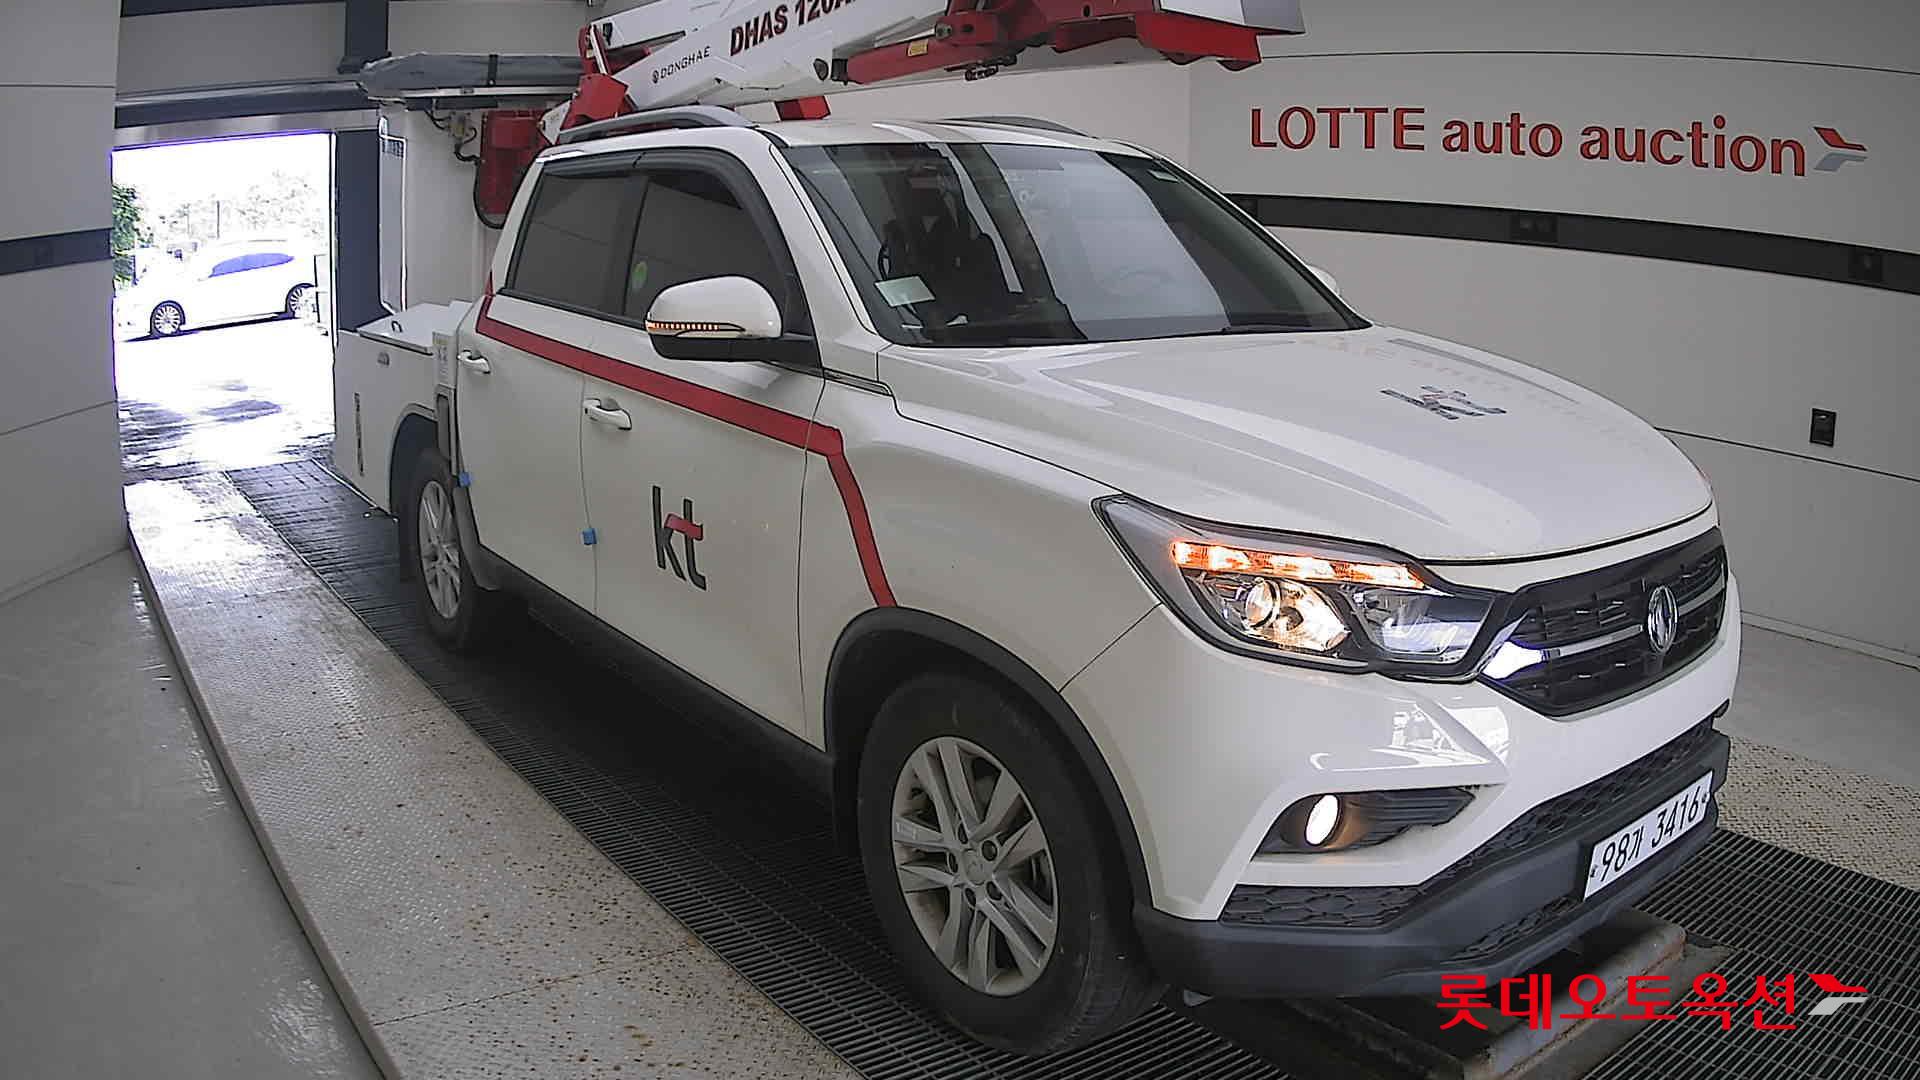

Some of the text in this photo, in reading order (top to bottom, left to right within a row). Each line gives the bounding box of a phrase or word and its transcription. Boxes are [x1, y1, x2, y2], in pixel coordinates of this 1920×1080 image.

[730, 0, 852, 56] DHAS 120
[660, 46, 710, 79] DONGHAE
[1251, 107, 1806, 177] LOTTE auto auction
[652, 485, 706, 591] kt
[1652, 786, 1701, 848] 3416
